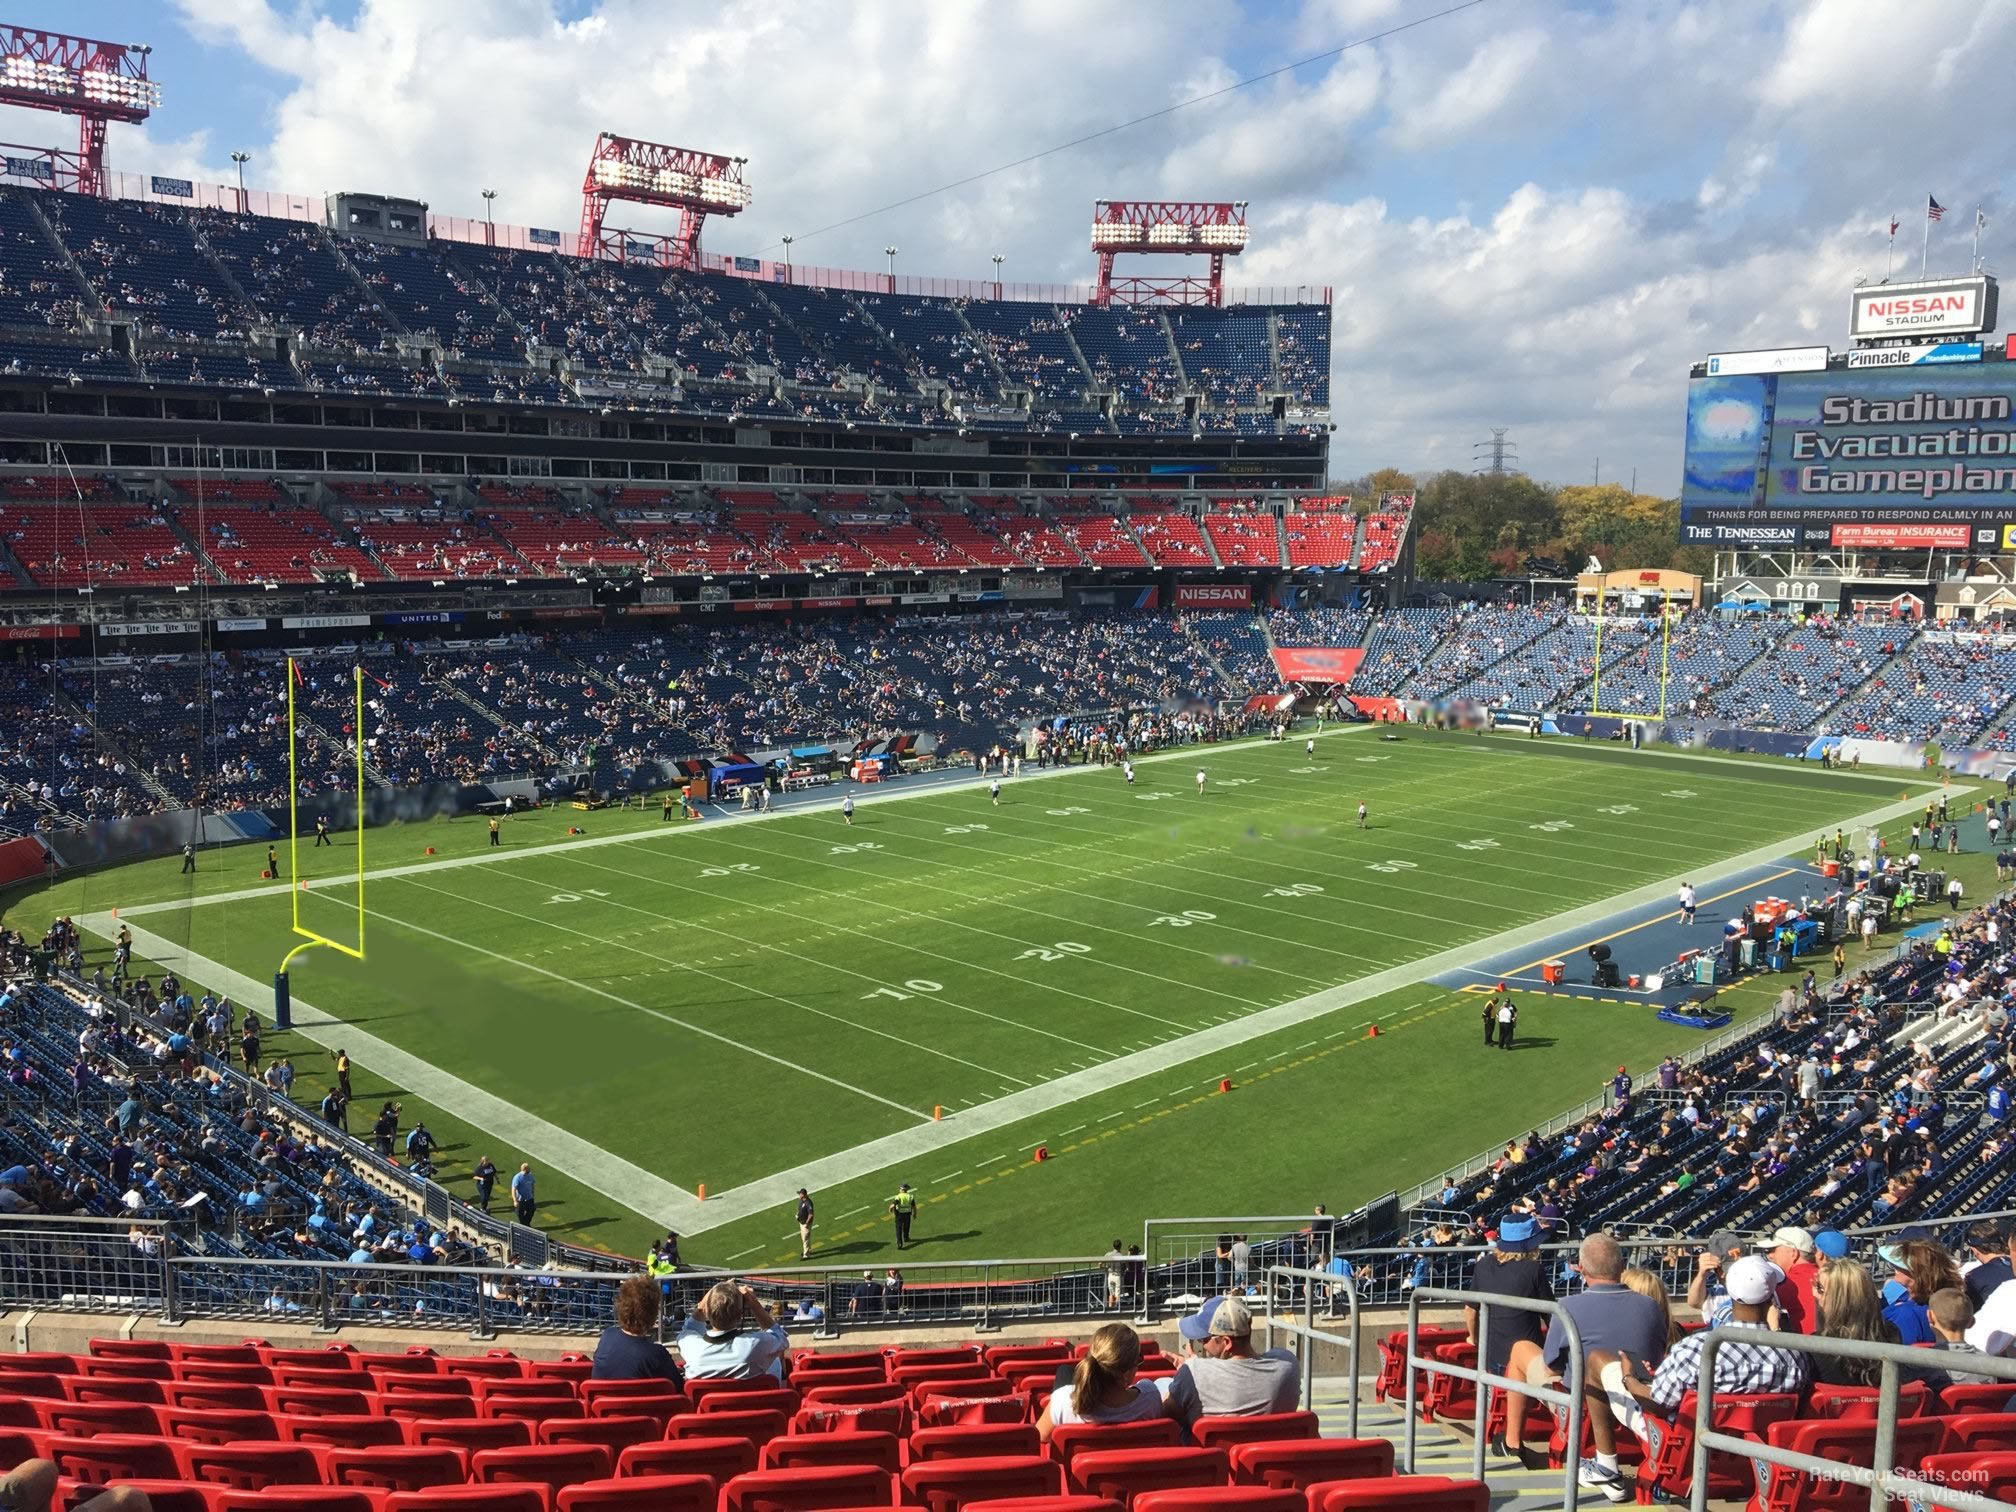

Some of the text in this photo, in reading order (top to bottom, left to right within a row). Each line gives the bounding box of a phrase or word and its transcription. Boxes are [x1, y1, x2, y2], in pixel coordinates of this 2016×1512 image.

[14, 159, 45, 169] STEVE
[10, 166, 50, 178] McNAIR
[157, 178, 188, 188] WARREN
[154, 184, 192, 197] MOON
[1868, 296, 1965, 317] NISSAN
[1886, 314, 1945, 325] STADIUM
[1850, 350, 1910, 366] Pinnacle
[1823, 392, 2009, 425] Stadium
[1793, 427, 2016, 460] Evacuatio
[1707, 510, 2013, 519] THANKS FOR BEING PREPARED TO RESPOND CALMLY IN AN
[1687, 526, 1796, 539] THE TENNESSEAN
[1836, 527, 1966, 537] Farm Bureau INSURANCE
[1180, 588, 1247, 600] NISSAN
[700, 604, 715, 612] CMT
[754, 602, 773, 610] xfinity
[401, 614, 438, 623] UNITED
[106, 626, 121, 635] Lite
[126, 625, 140, 634] Lite
[145, 625, 160, 633] Lite
[164, 624, 179, 632] Lite
[183, 623, 197, 631] Lite
[1301, 674, 1333, 682] NISSAN
[1529, 820, 1574, 831] 30
[1456, 838, 1501, 850] 40
[1365, 860, 1418, 873] 50
[1272, 883, 1325, 898] 40
[1155, 910, 1217, 927] 30
[1024, 942, 1092, 962] 20
[1554, 969, 1562, 977] G
[873, 979, 944, 1001] 10
